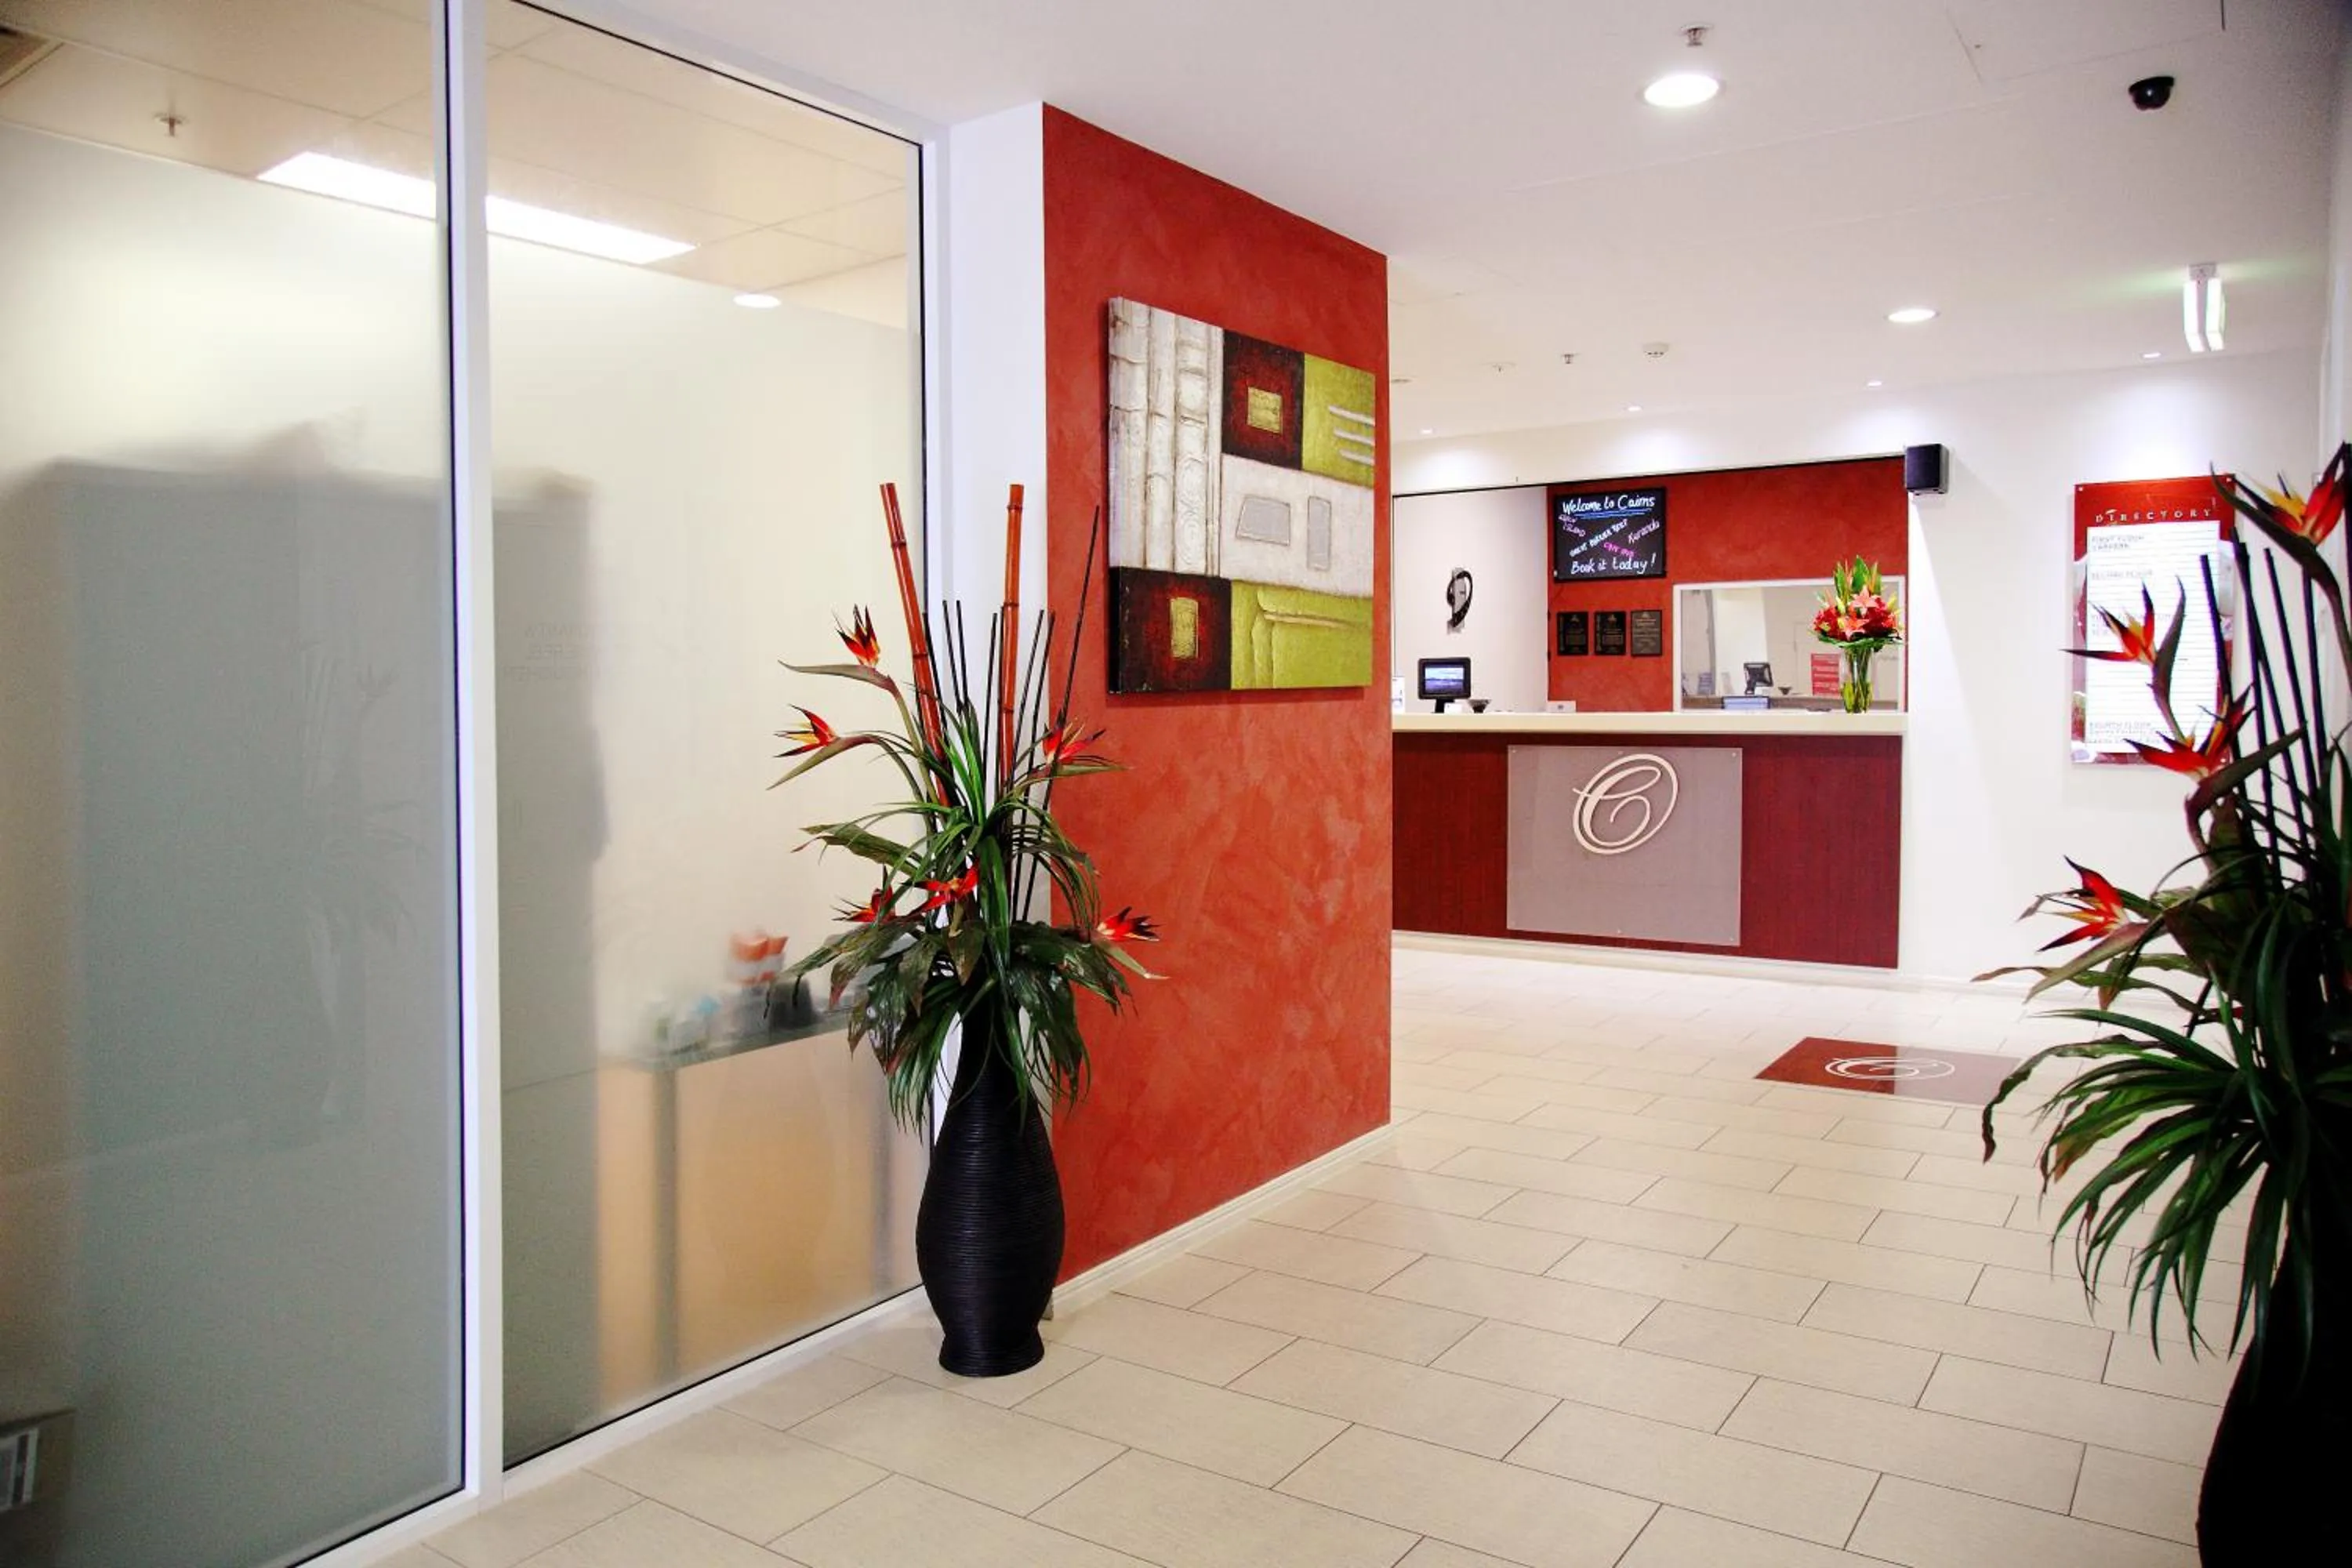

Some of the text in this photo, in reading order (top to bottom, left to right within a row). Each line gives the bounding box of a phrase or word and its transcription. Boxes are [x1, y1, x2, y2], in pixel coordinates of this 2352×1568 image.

[1563, 495, 1657, 514] Welcome to Cairns
[2096, 509, 2211, 523] DIRECTORY
[1570, 557, 1595, 575] Book
[1597, 557, 1606, 571] it
